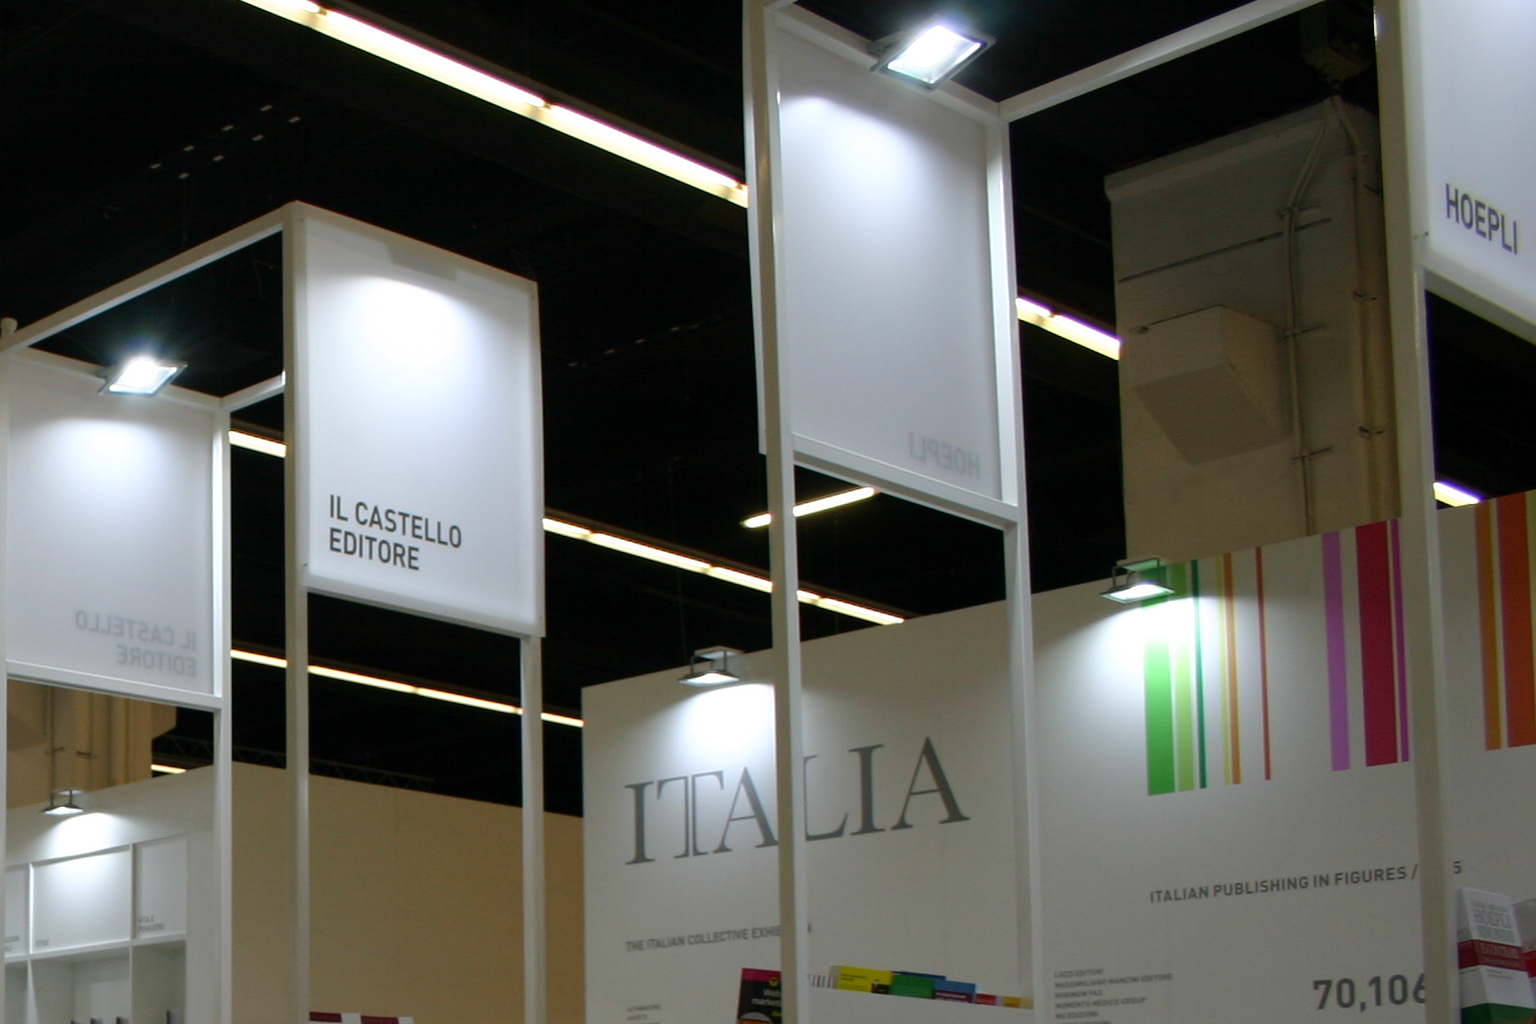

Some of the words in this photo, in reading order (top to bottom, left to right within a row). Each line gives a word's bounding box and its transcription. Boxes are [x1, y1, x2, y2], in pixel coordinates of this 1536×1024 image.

[1445, 182, 1518, 255] HOEPLI
[329, 494, 349, 523] IL
[354, 501, 462, 549] CASTELLO
[329, 527, 420, 571] EDITORE
[624, 736, 971, 865] ITALIA
[1150, 886, 1209, 903] ITALIAN
[1212, 876, 1309, 898] PUBLISHING
[1313, 873, 1330, 888] IN
[1334, 866, 1407, 886] FIGURES
[625, 940, 645, 952] THE
[646, 935, 685, 949] ITALIAN
[687, 928, 749, 946] COLLECTIVE
[1312, 973, 1426, 1012] 70,106
